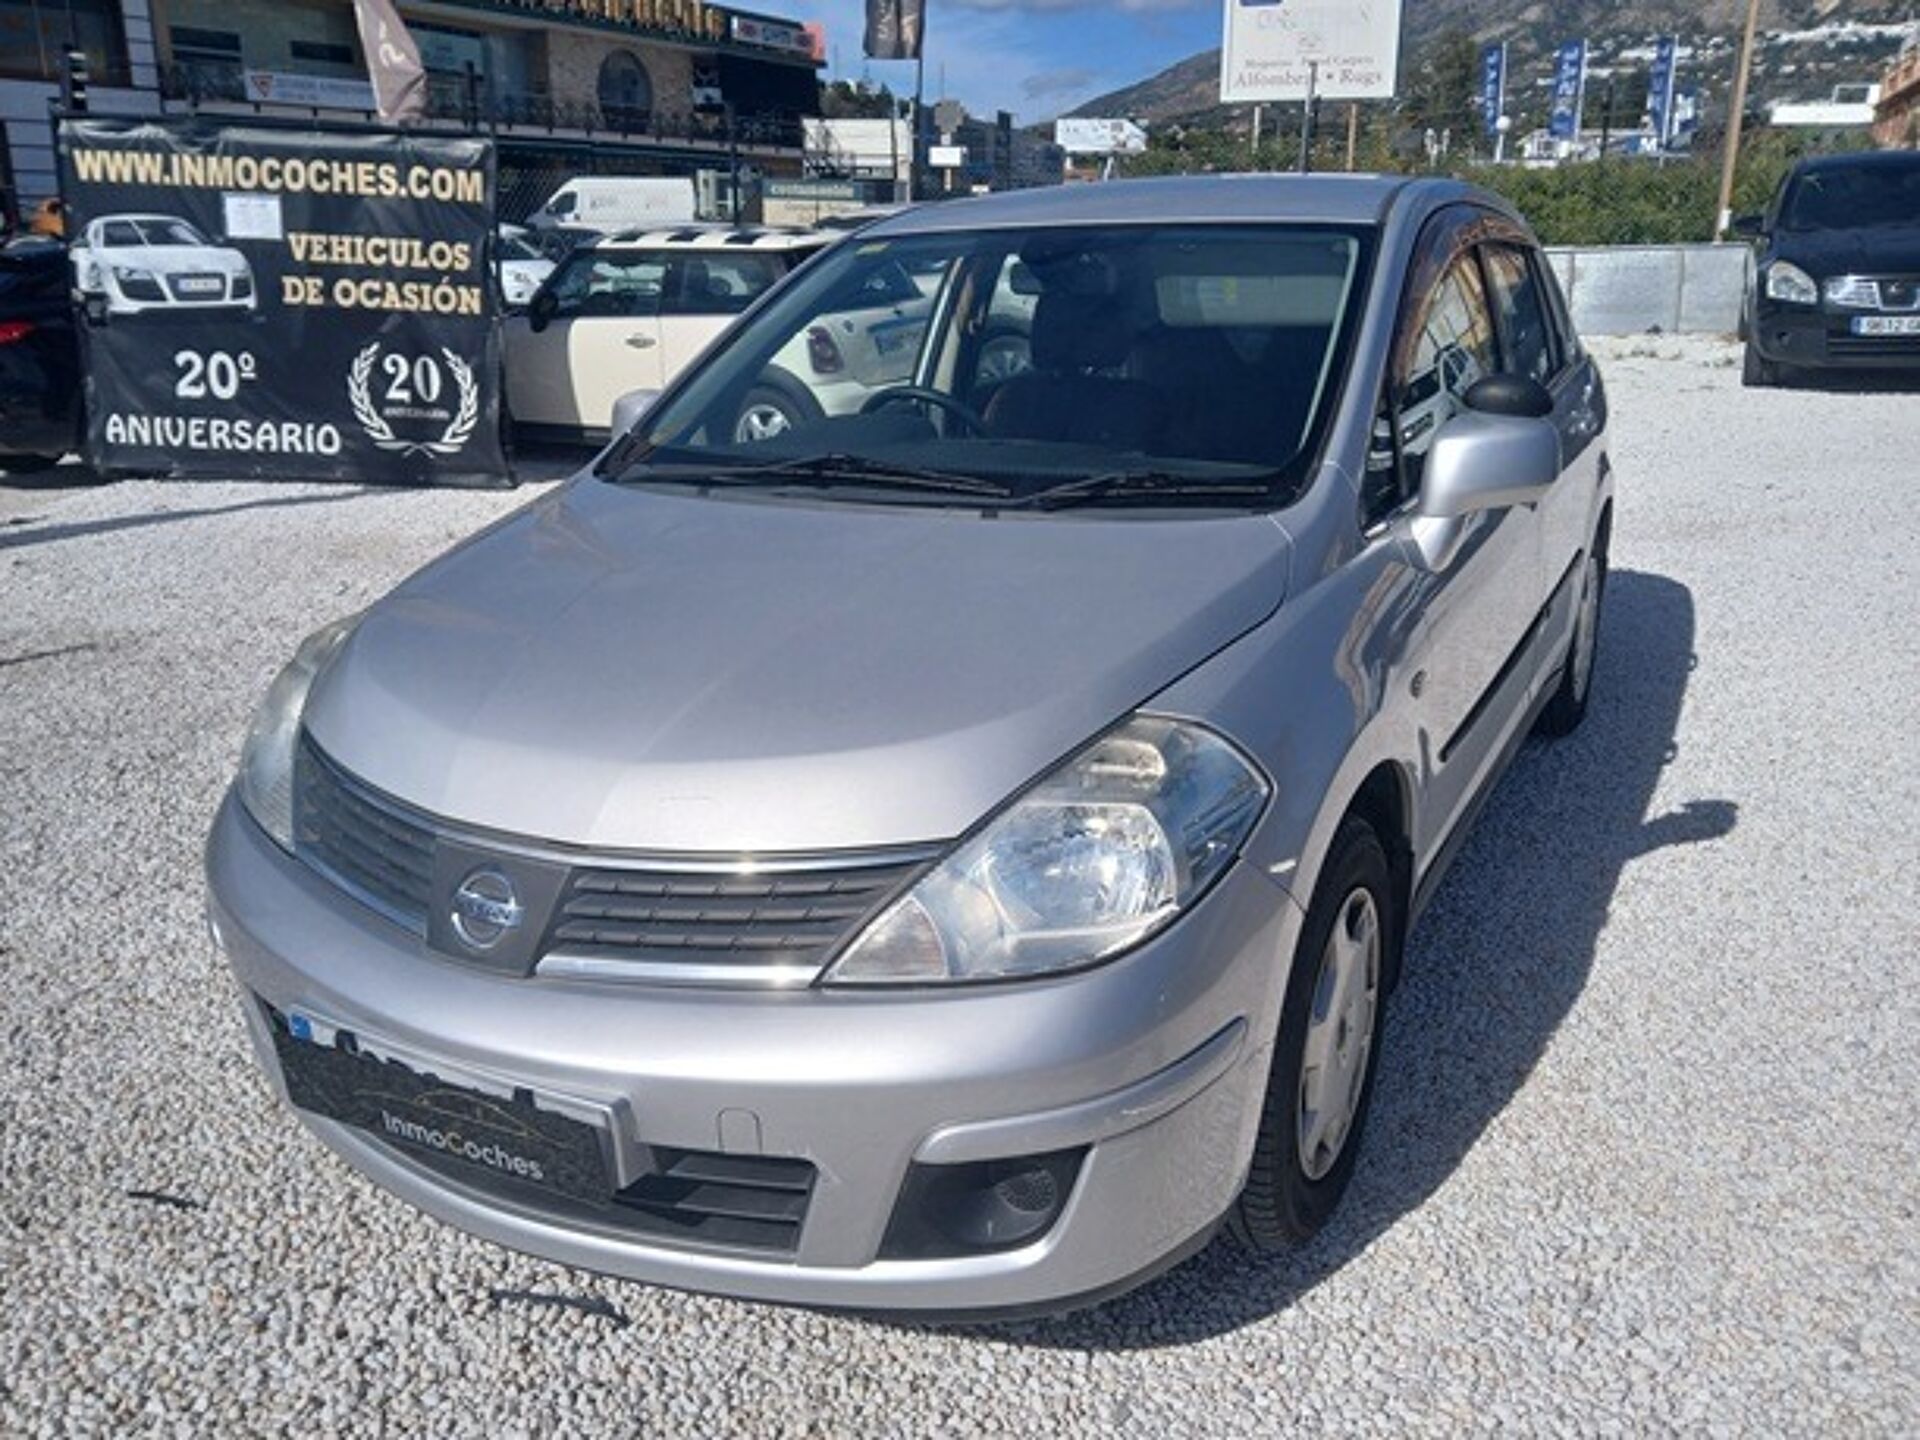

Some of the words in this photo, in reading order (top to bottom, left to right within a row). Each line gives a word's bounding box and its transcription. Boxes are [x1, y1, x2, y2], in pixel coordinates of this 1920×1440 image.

[73, 150, 483, 203] WWW.INMOCOCHES.COM
[288, 232, 471, 271] VEHICULOS
[282, 276, 325, 305] DE
[334, 275, 481, 315] OCASIÓN
[382, 353, 441, 404] 20
[106, 413, 342, 456] ANIVERSARIO
[381, 1110, 545, 1180] InmoCoches
